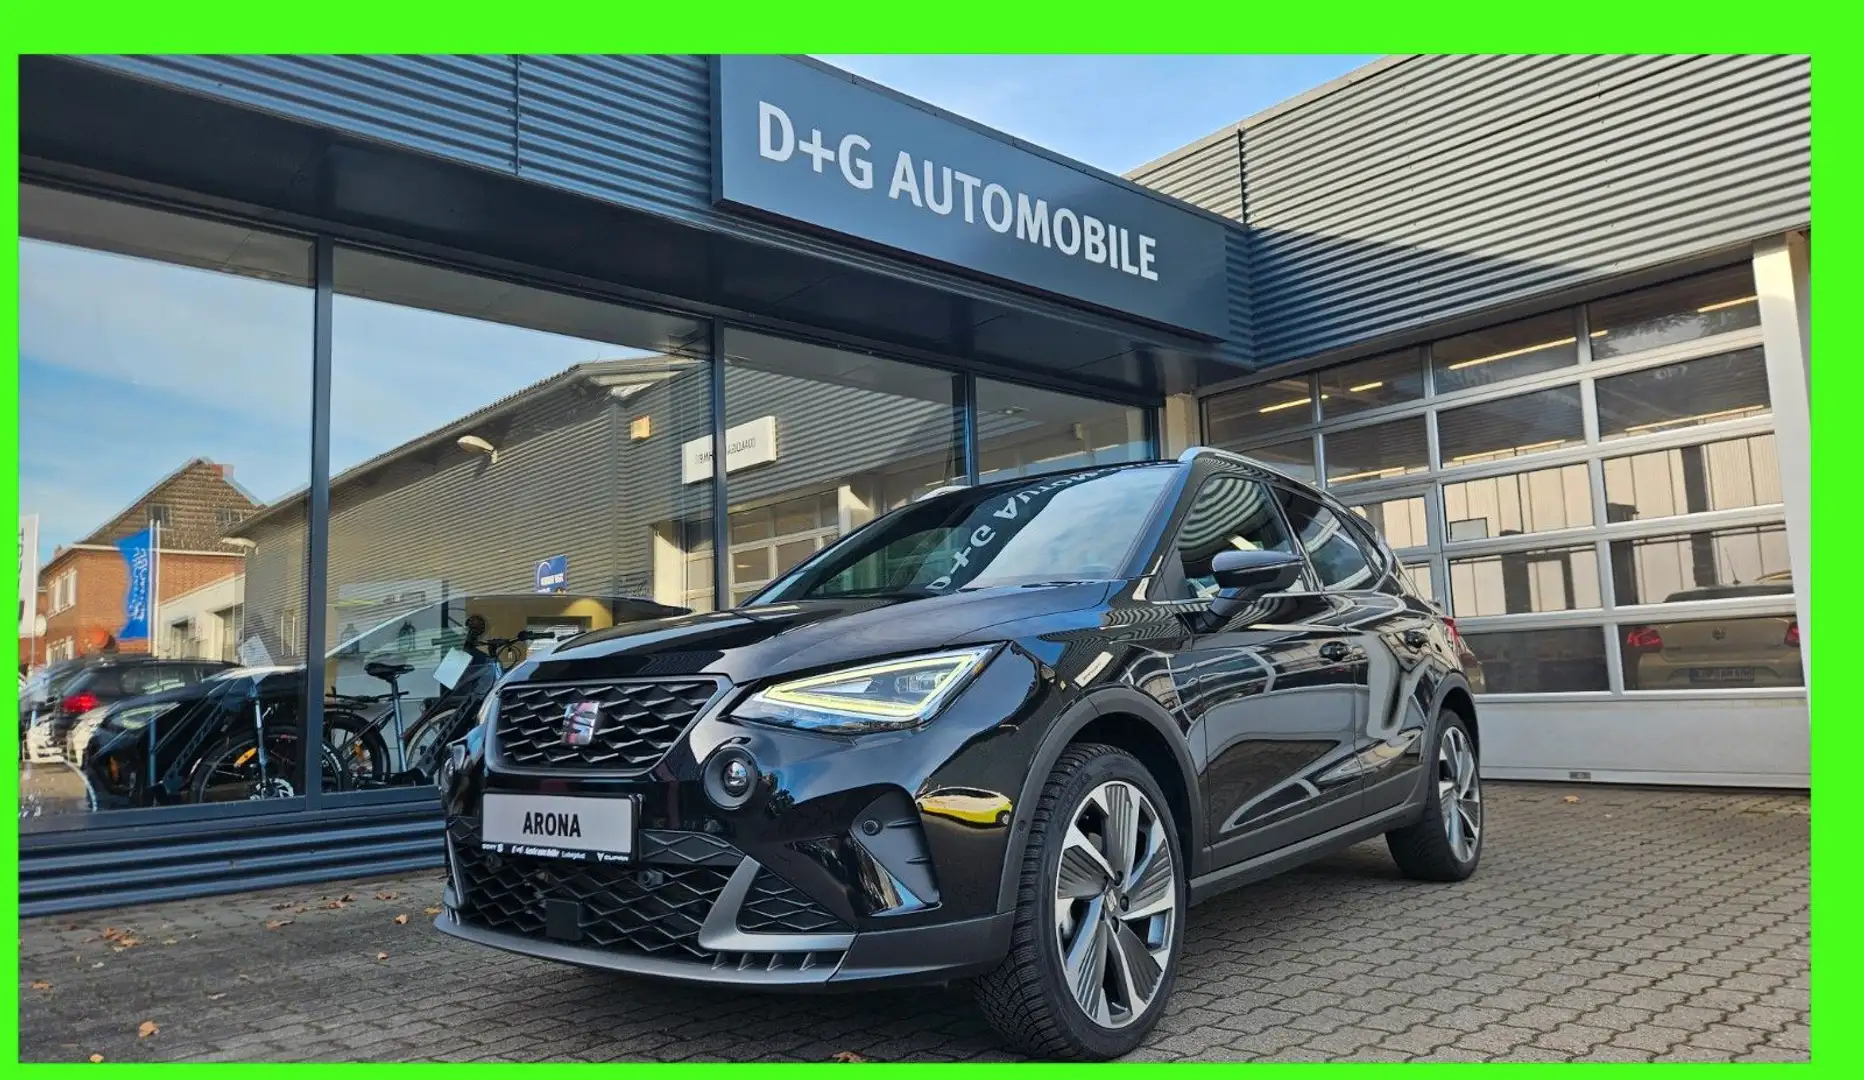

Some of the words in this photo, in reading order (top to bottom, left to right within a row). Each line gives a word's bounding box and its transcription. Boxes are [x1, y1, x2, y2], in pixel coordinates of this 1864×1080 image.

[759, 101, 873, 190] D+G
[888, 150, 1159, 282] AUTOMOBILE
[522, 811, 582, 838] ARONA
